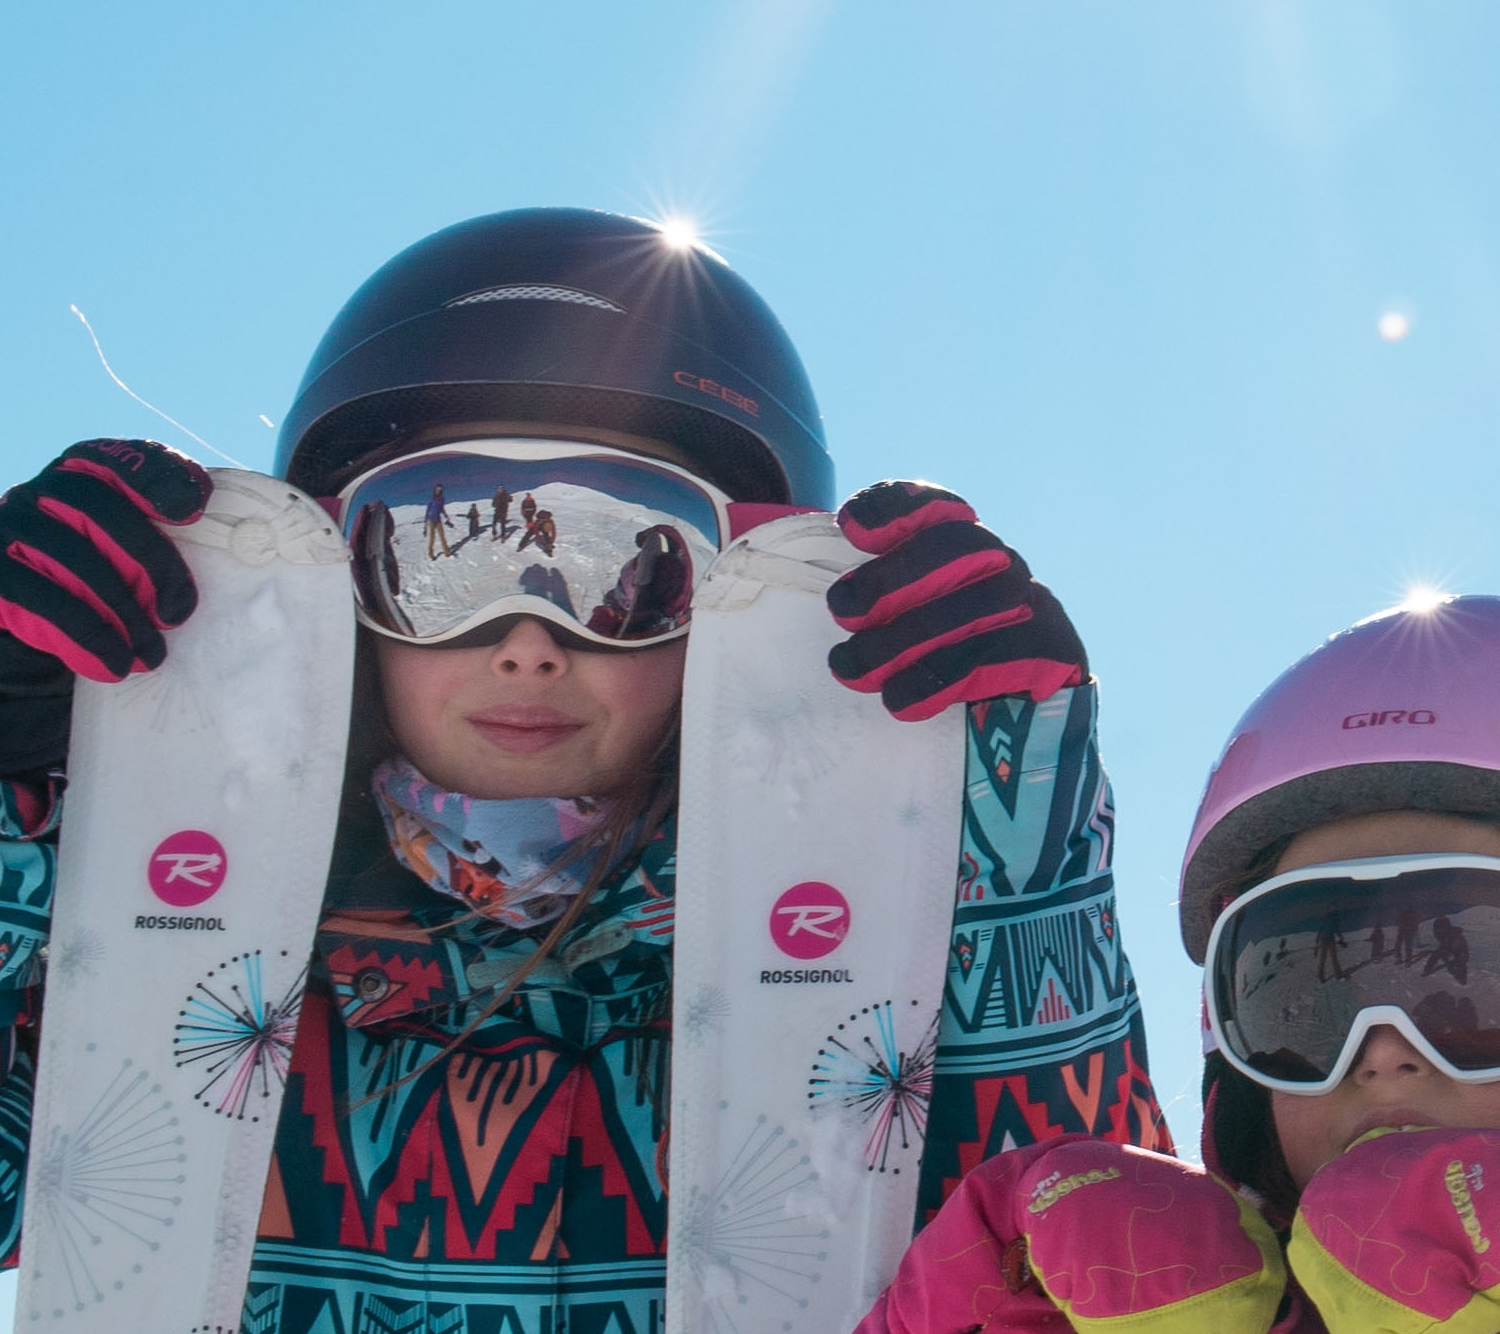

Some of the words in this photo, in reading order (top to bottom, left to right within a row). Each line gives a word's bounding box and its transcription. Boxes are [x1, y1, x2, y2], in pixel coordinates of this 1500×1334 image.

[1341, 709, 1437, 731] GIRO
[134, 914, 228, 932] ROSSIGNOL
[759, 969, 854, 985] ROSSIGNOL
